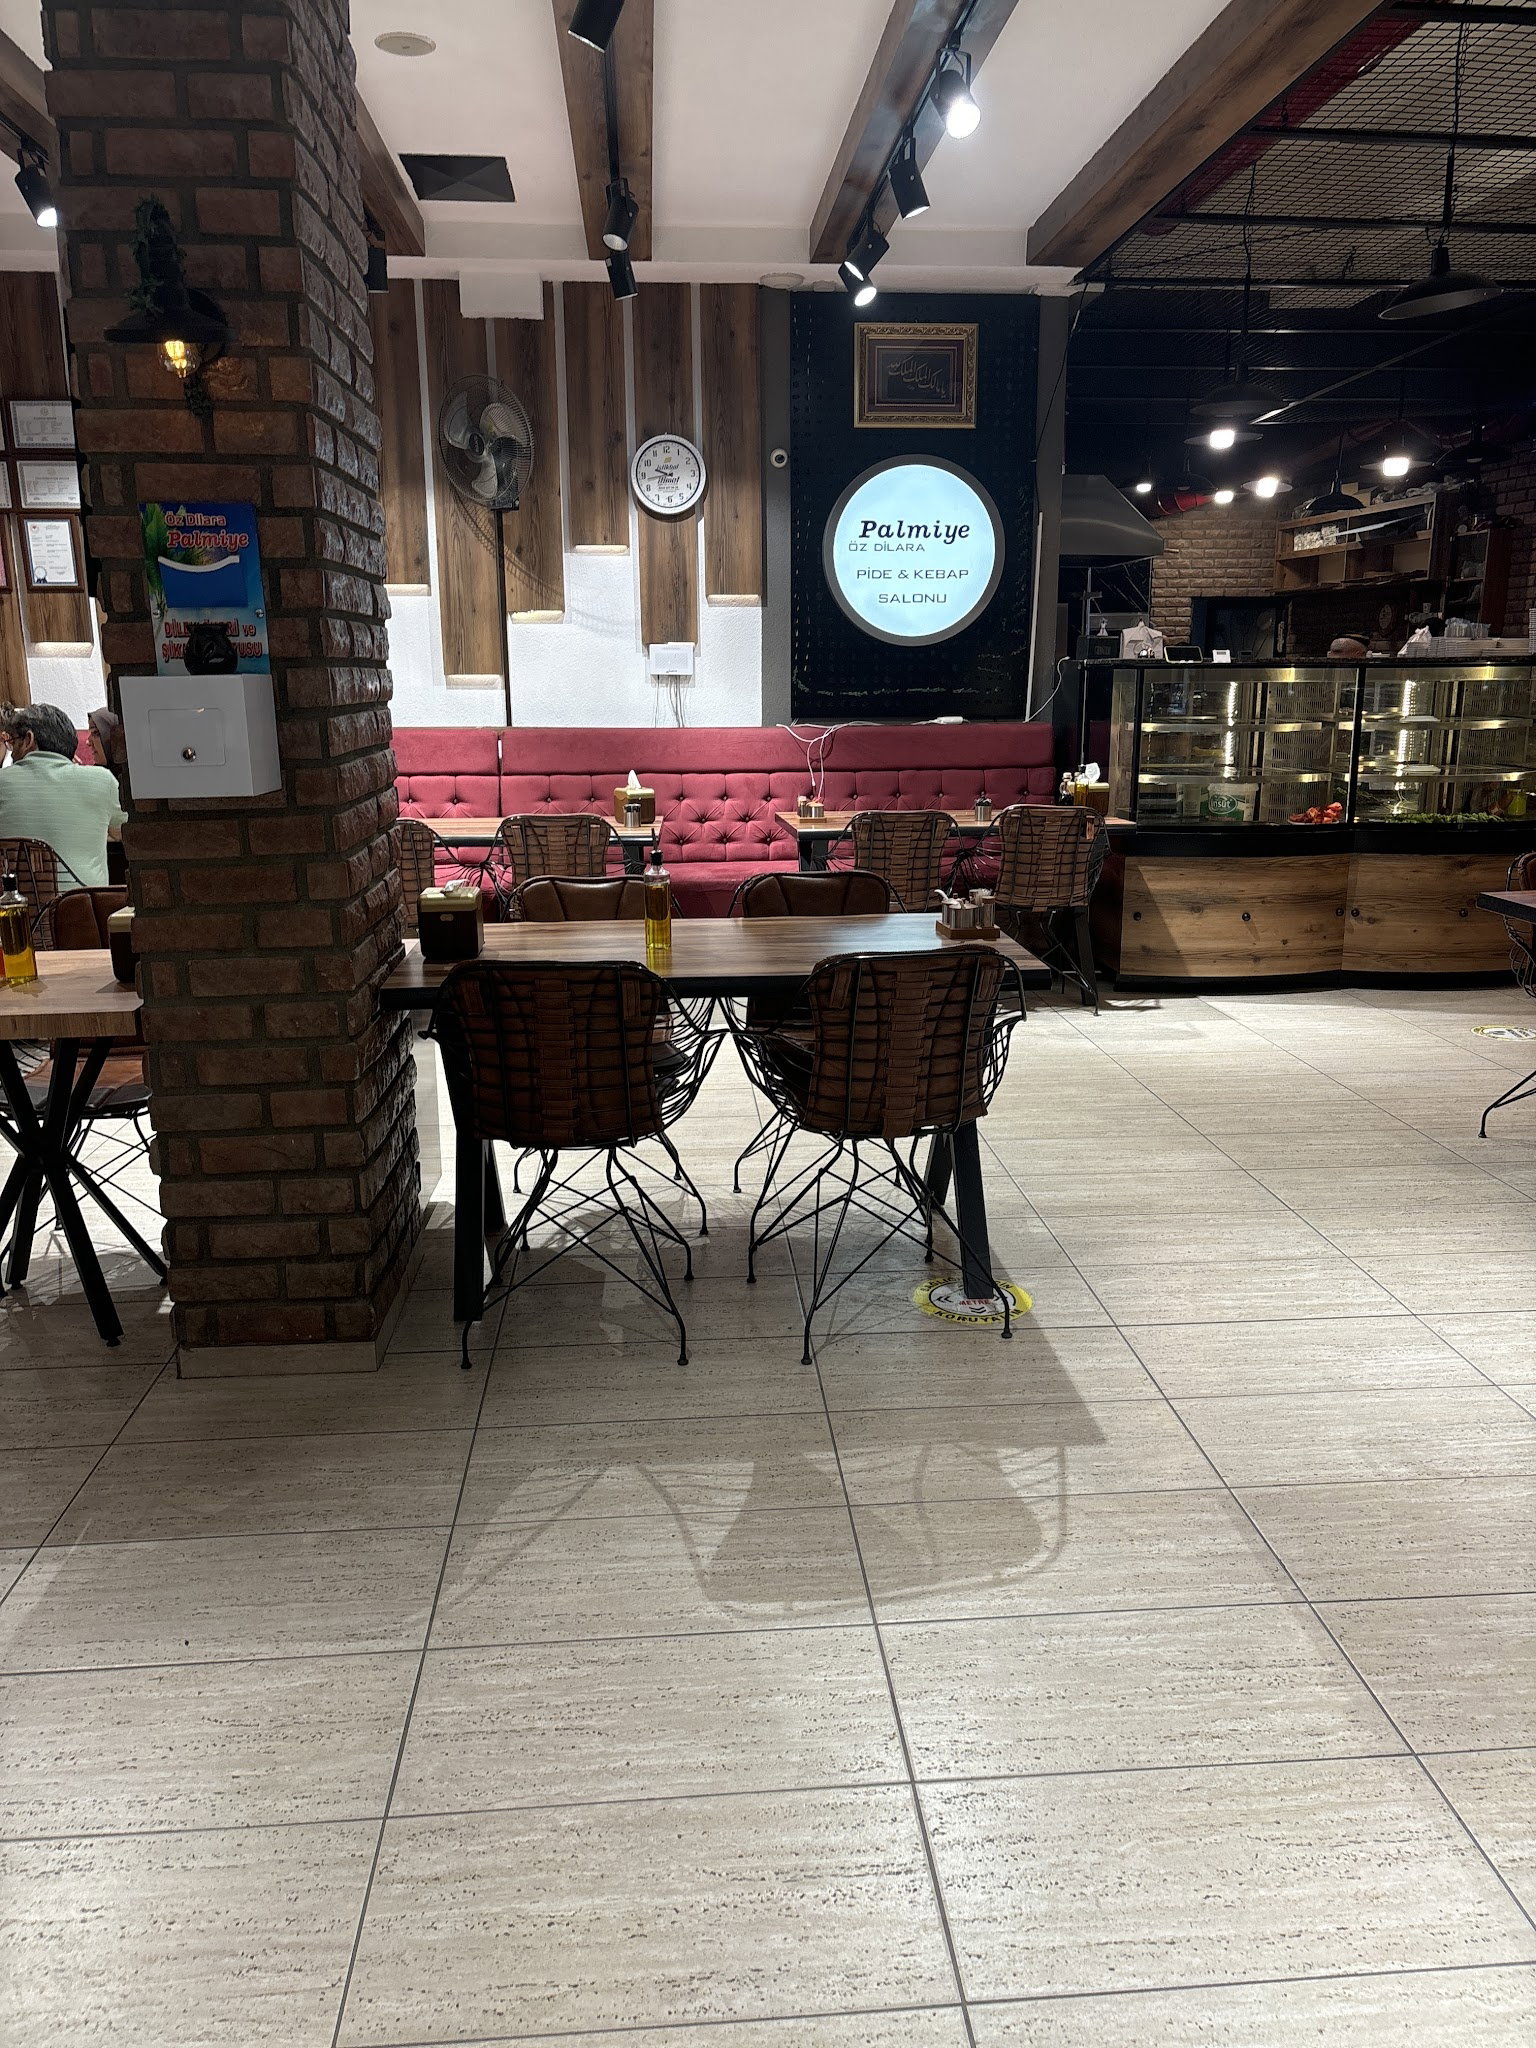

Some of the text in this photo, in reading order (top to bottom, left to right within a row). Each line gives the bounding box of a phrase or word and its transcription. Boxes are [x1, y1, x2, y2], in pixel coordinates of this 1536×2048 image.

[663, 446, 670, 454] 12
[644, 459, 652, 467] 10
[685, 457, 691, 465] 2
[641, 472, 646, 480] 9
[646, 484, 651, 492] 8
[686, 482, 692, 490] 4
[655, 493, 660, 502] 7
[667, 495, 673, 503] 6
[679, 492, 684, 500] 5
[165, 511, 184, 526] Öz
[859, 520, 970, 545] Palmiye
[167, 529, 249, 552] Palmiye
[849, 541, 925, 552] ÖZ DİLARA
[857, 567, 969, 579] PİDE & KEBAP
[878, 593, 947, 603] SALONU
[242, 624, 256, 637] ve
